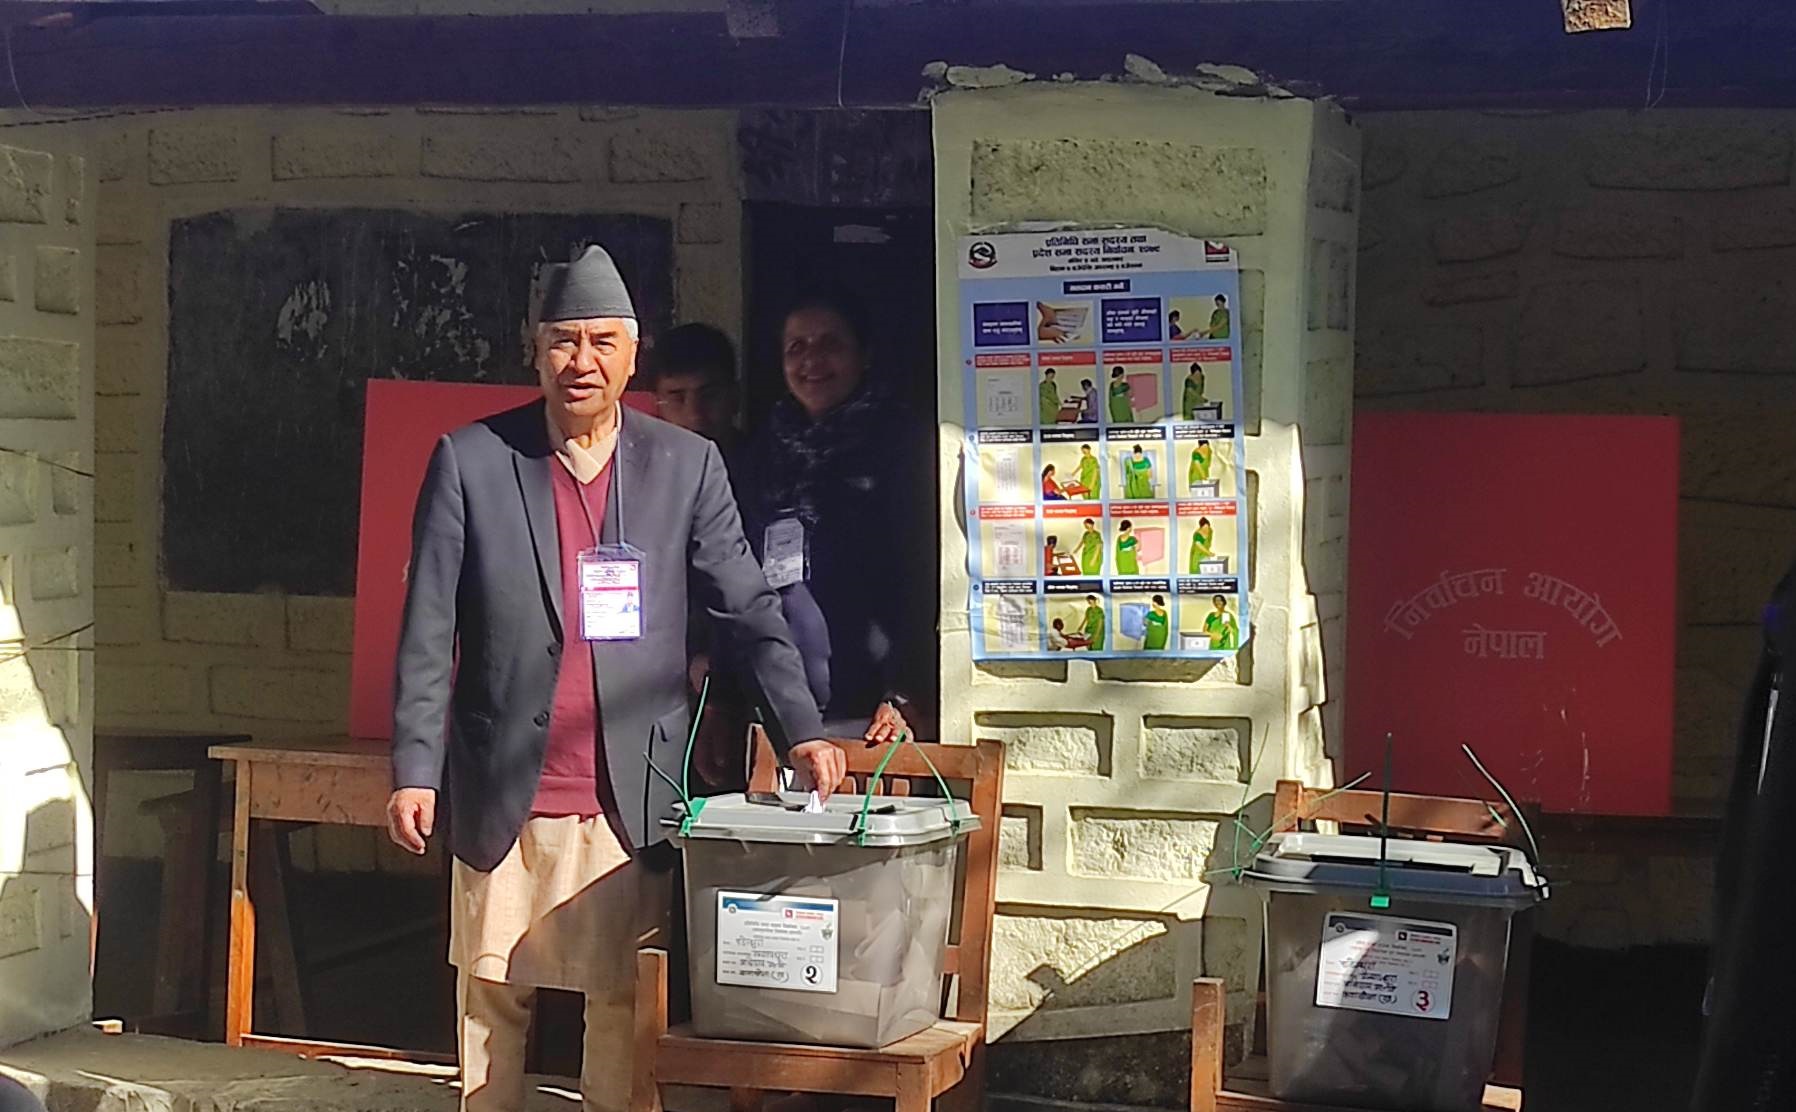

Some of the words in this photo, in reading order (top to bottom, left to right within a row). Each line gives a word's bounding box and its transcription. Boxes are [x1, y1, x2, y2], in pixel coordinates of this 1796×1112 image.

[1383, 568, 1507, 640] निर्वाचन
[1523, 572, 1623, 648] आयोग
[1462, 623, 1547, 659] नेपाल
[1416, 990, 1430, 1011] ३
